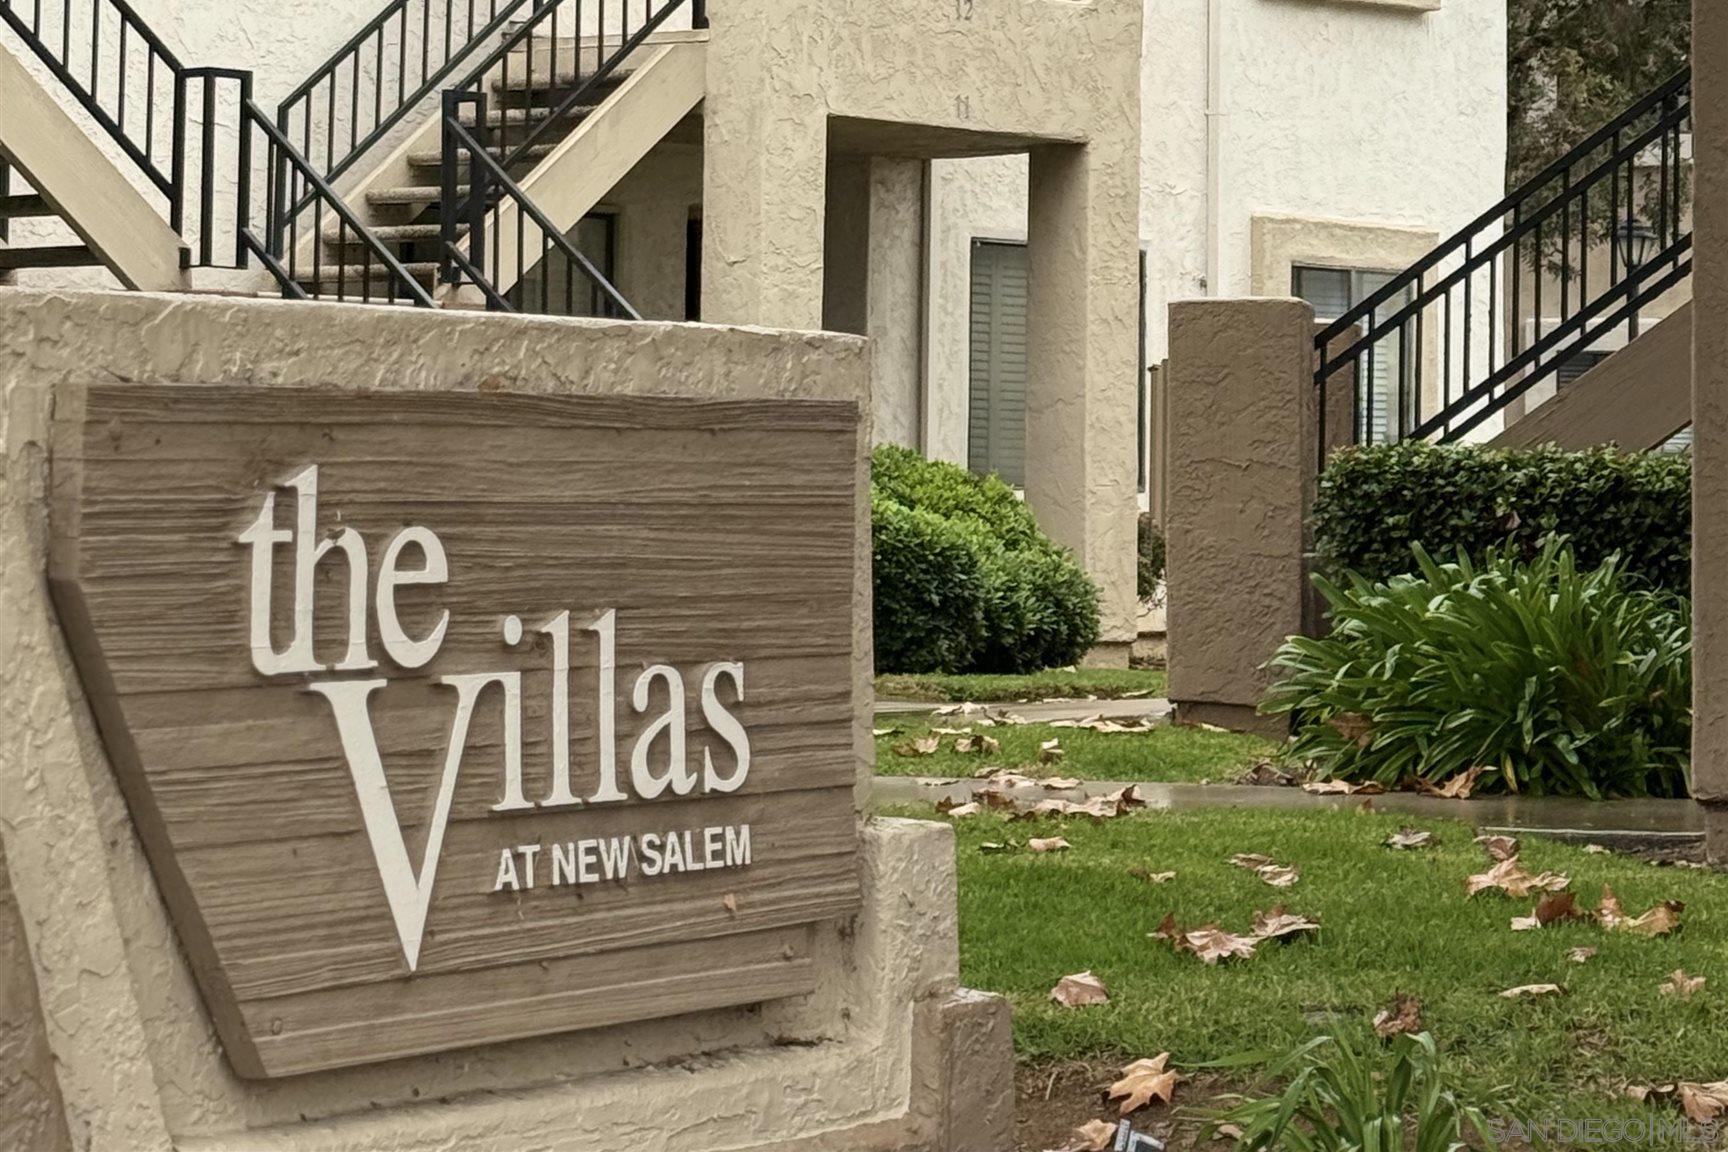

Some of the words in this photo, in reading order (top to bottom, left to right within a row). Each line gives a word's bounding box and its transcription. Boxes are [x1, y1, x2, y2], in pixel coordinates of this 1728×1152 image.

[954, 94, 970, 120] 11
[239, 464, 449, 675] the
[310, 609, 750, 971] Villas
[494, 845, 540, 890] AT
[552, 836, 630, 885] NEW
[641, 824, 751, 875] SALEM
